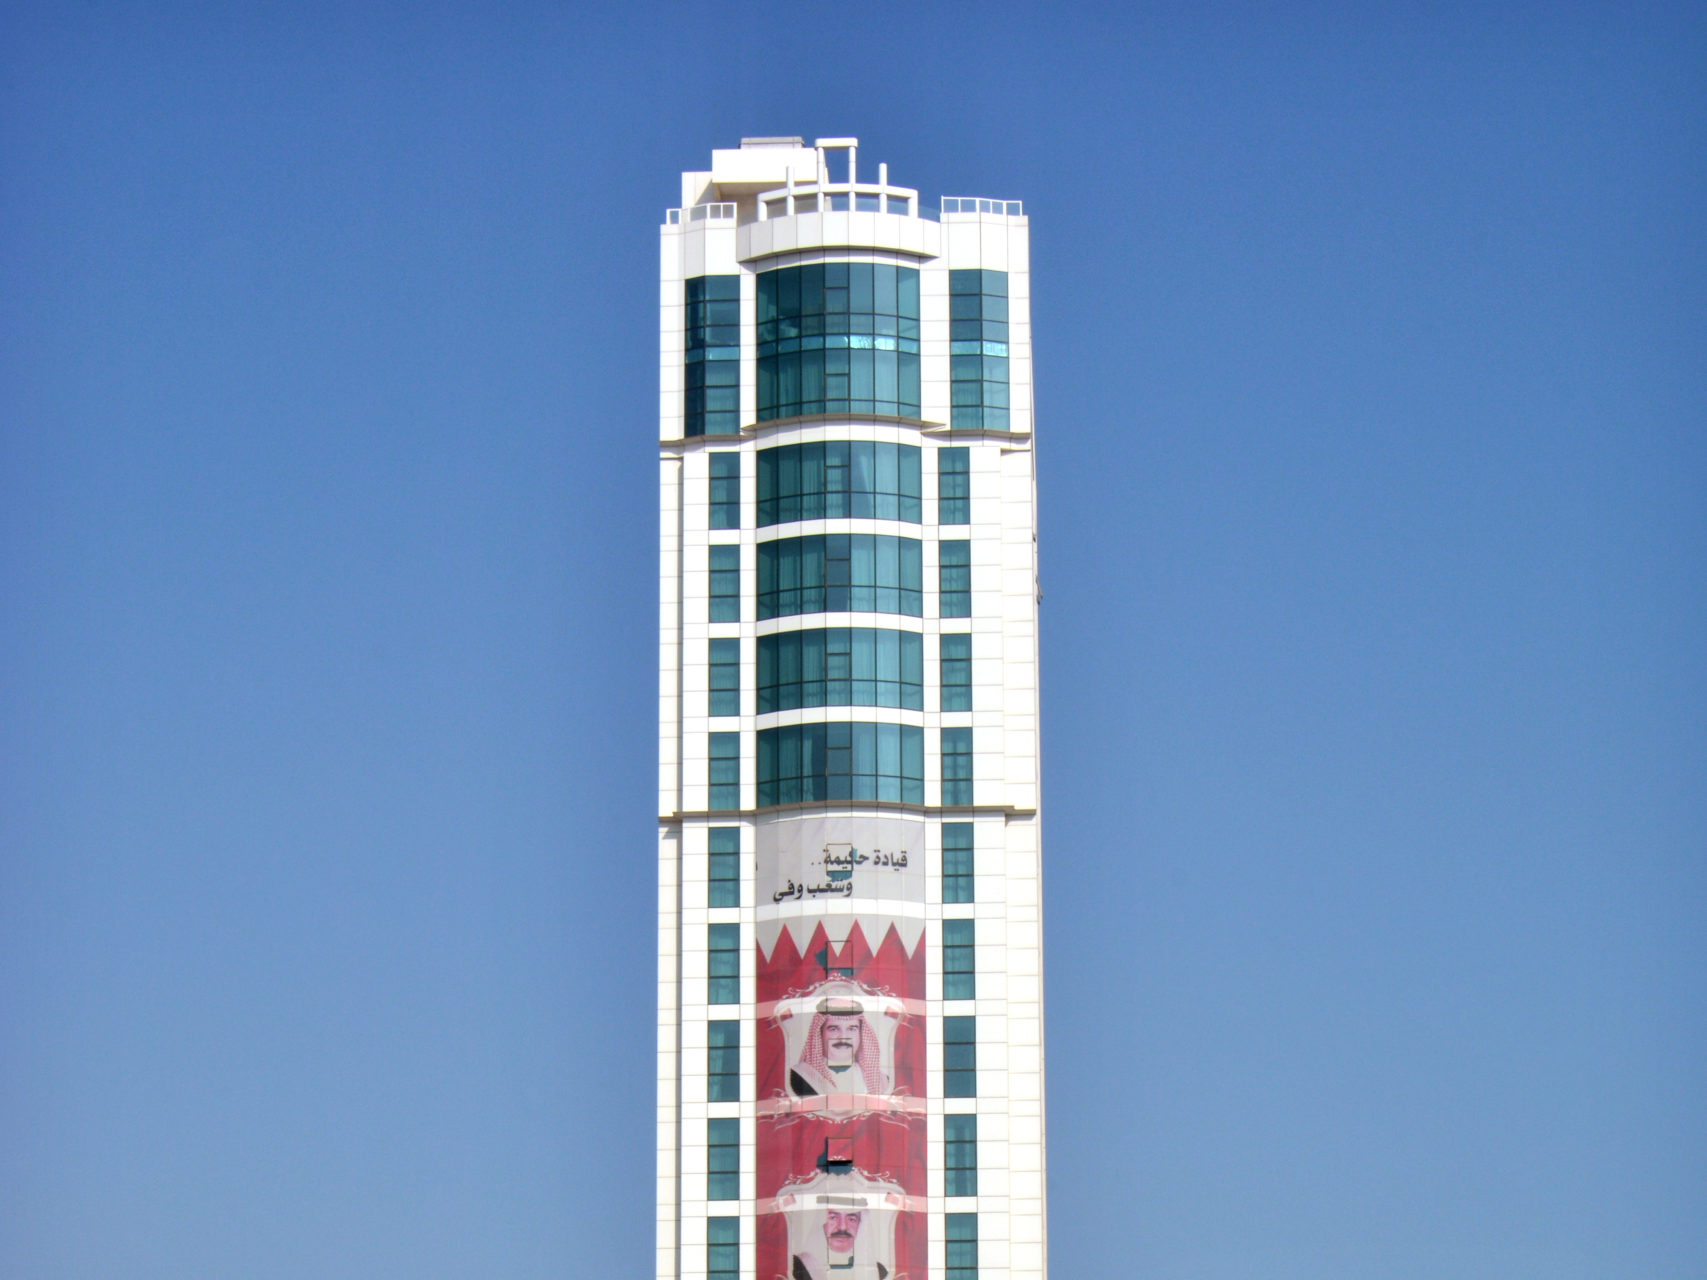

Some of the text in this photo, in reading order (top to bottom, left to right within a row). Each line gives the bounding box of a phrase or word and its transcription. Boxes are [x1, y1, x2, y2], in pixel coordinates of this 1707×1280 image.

[873, 850, 908, 871] قيادة
[773, 879, 853, 903] وشعب وفي
